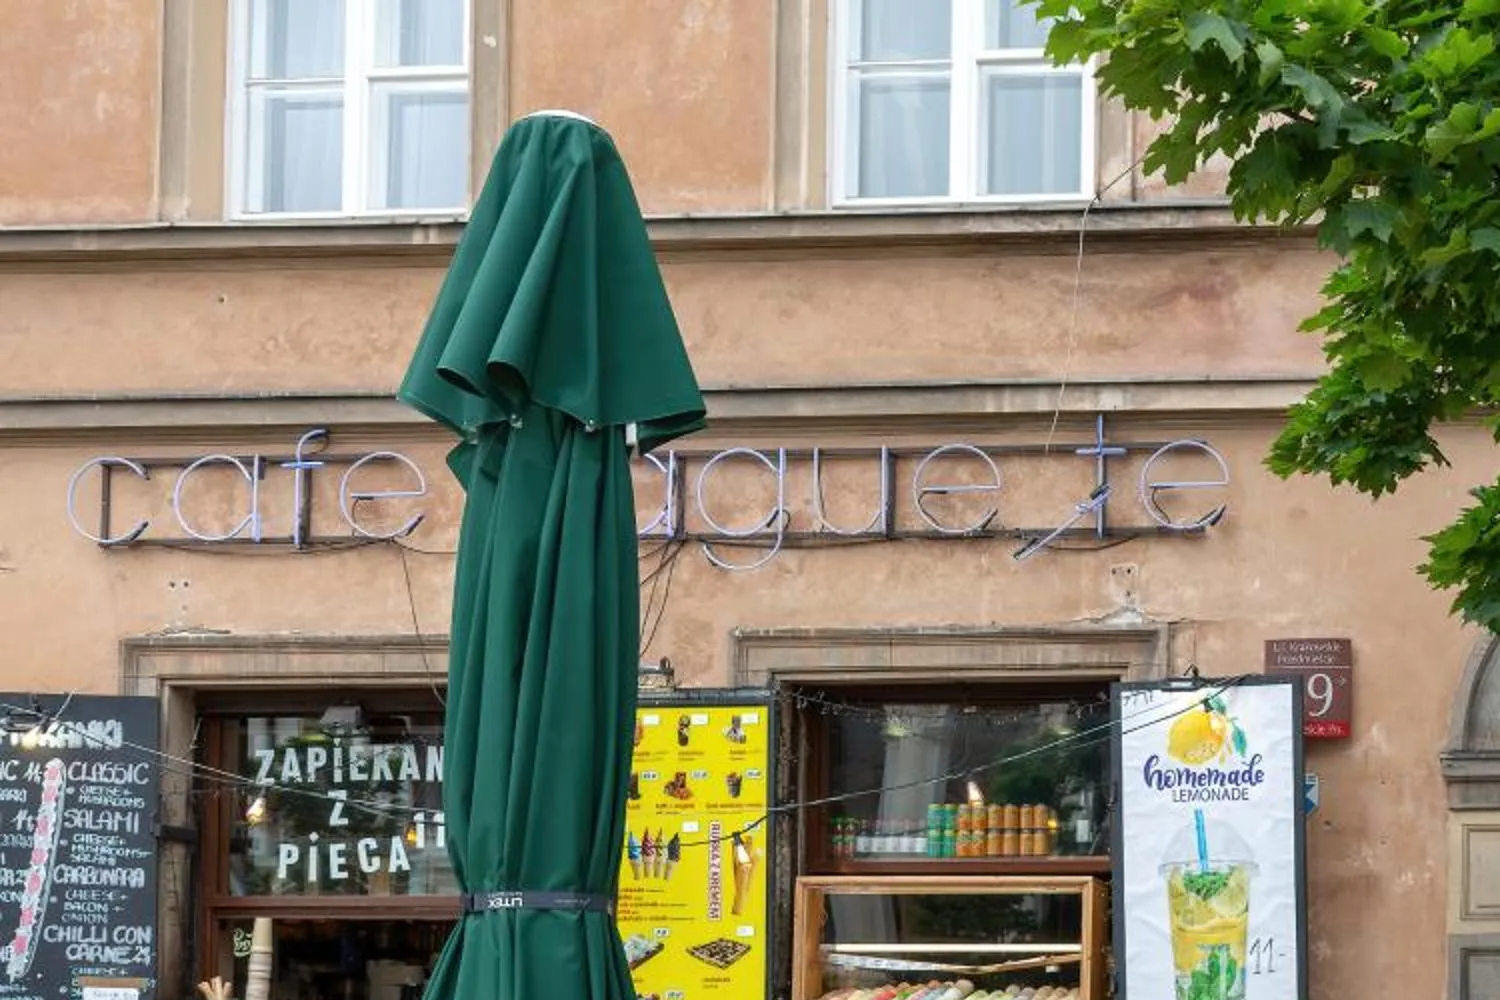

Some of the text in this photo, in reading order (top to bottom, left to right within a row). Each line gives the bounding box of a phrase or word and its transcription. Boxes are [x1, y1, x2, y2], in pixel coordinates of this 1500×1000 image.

[67, 428, 426, 546] cafe
[1307, 673, 1333, 717] 9
[67, 761, 149, 785] CLASSIC
[1143, 754, 1265, 791] homemade
[1171, 787, 1250, 804] LEMONADE
[63, 808, 139, 834] SALAMI
[328, 790, 349, 827] Z
[53, 864, 145, 888] CARBONARA
[44, 925, 152, 945] CHILLI CON
[65, 943, 131, 964] CARNE
